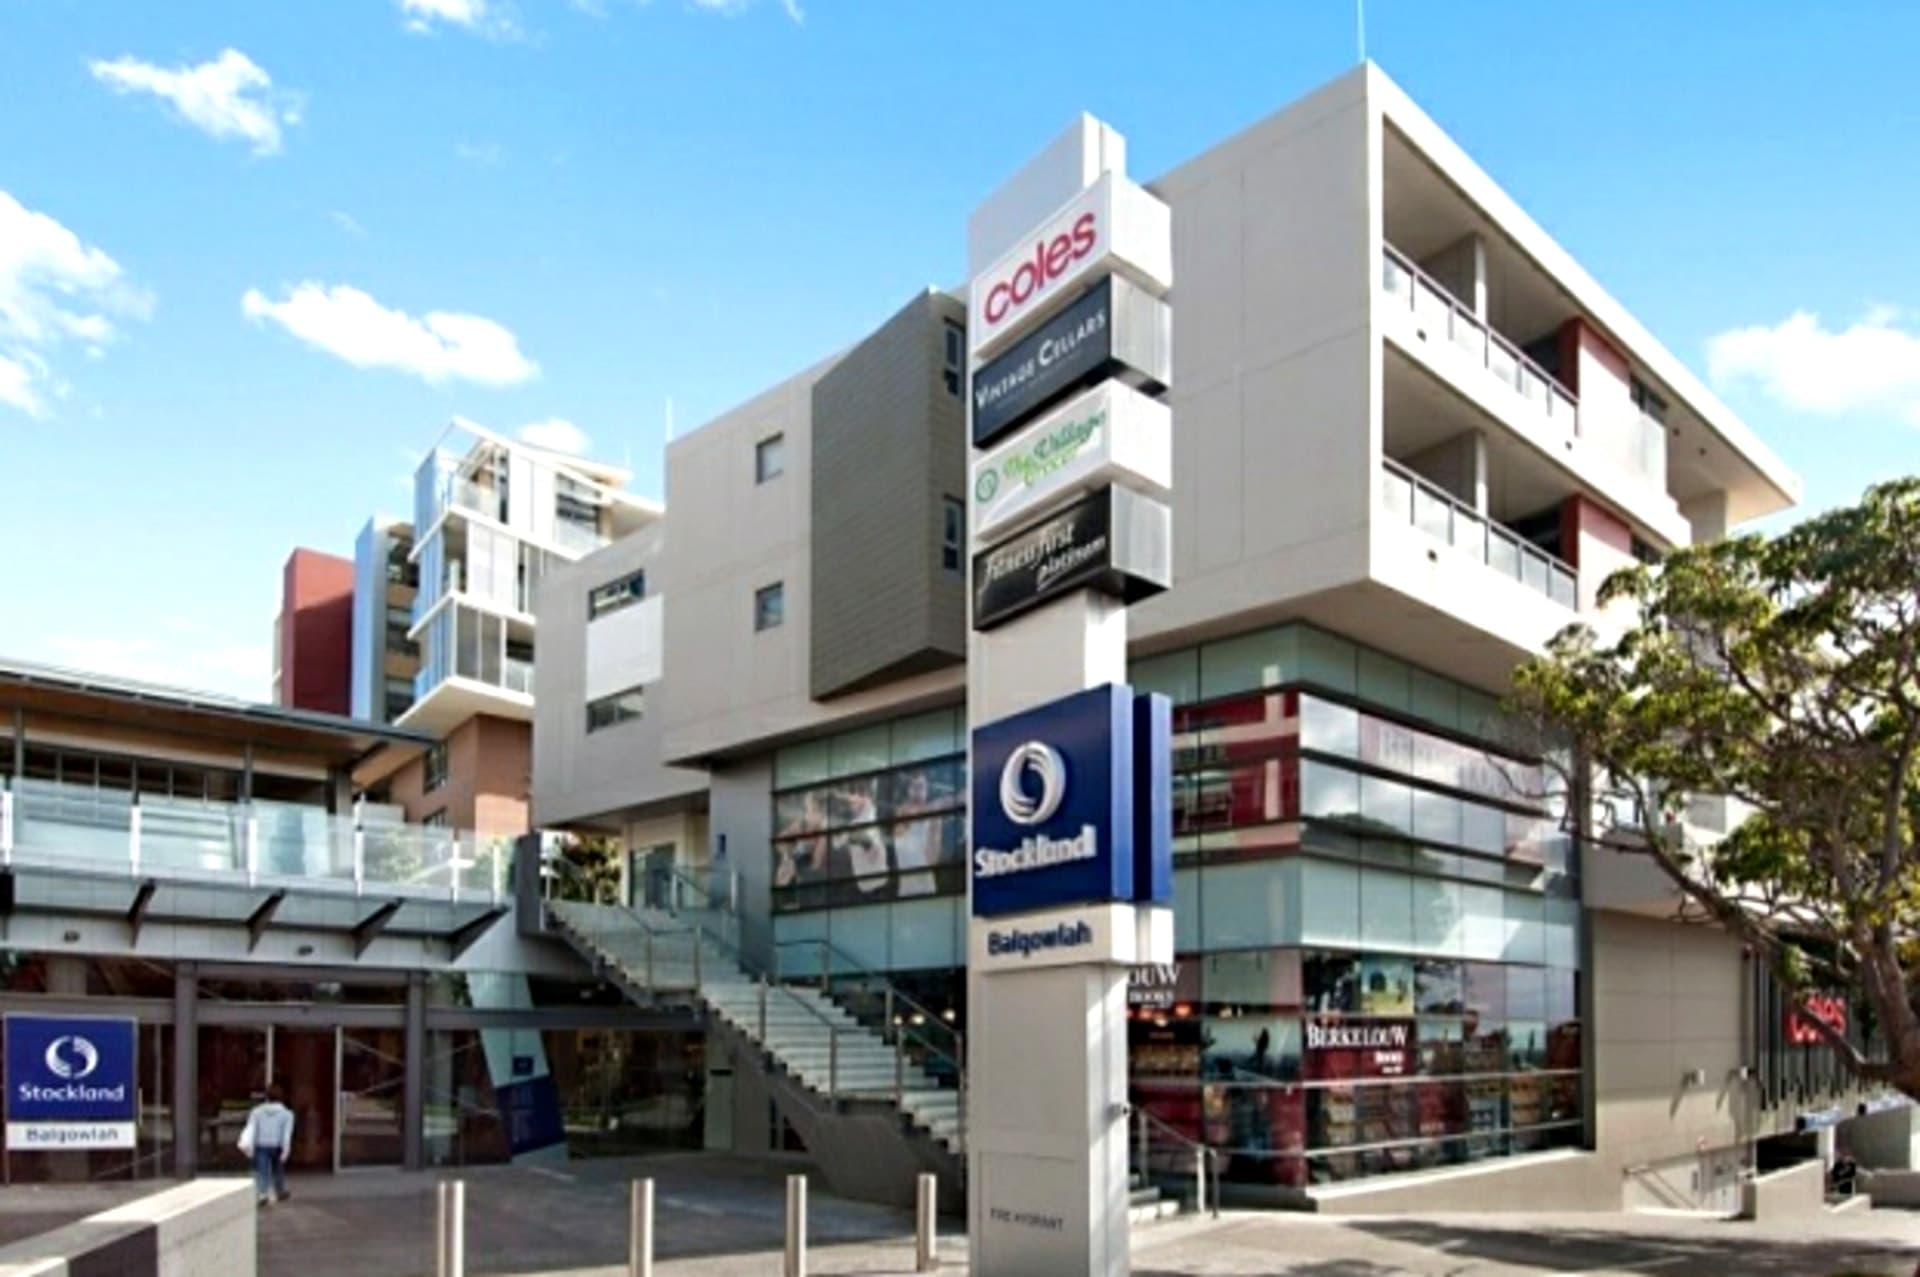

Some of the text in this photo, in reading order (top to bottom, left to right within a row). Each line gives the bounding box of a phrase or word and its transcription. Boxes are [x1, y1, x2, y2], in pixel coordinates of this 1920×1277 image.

[984, 212, 1097, 325] coles
[975, 823, 1097, 879] Stockland
[987, 921, 1092, 957] Balgowlah
[1306, 1023, 1408, 1050] BERKELOUW
[19, 1084, 124, 1102] Stockland
[27, 1125, 118, 1142] Balgowlah
